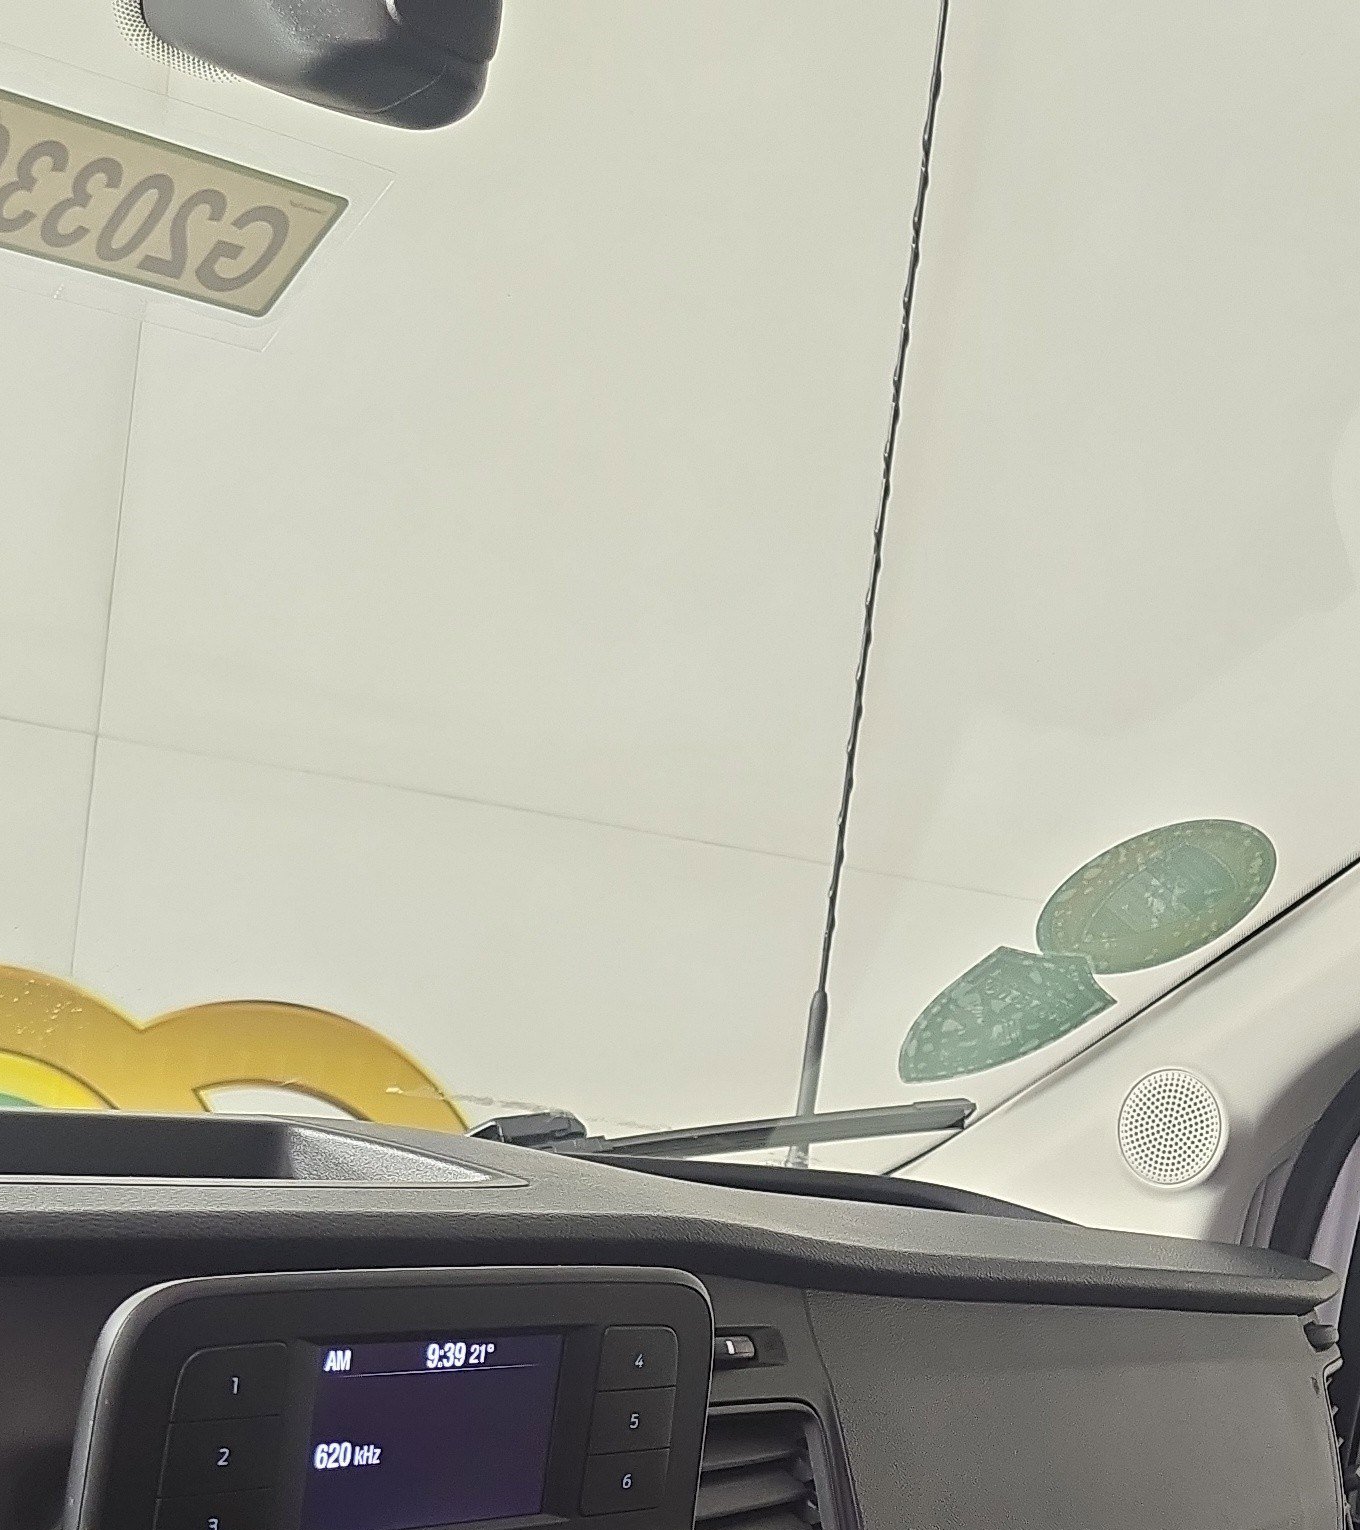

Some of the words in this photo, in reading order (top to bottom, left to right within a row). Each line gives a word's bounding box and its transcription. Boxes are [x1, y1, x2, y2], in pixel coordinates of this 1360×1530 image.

[324, 1350, 351, 1372] AM
[426, 1343, 466, 1369] 9:39
[634, 1353, 645, 1369] 4
[231, 1377, 240, 1395] 1
[629, 1413, 639, 1429] 5
[217, 1449, 229, 1467] 2
[314, 1442, 351, 1470] 620
[353, 1444, 381, 1467] kHz
[621, 1474, 632, 1490] 6
